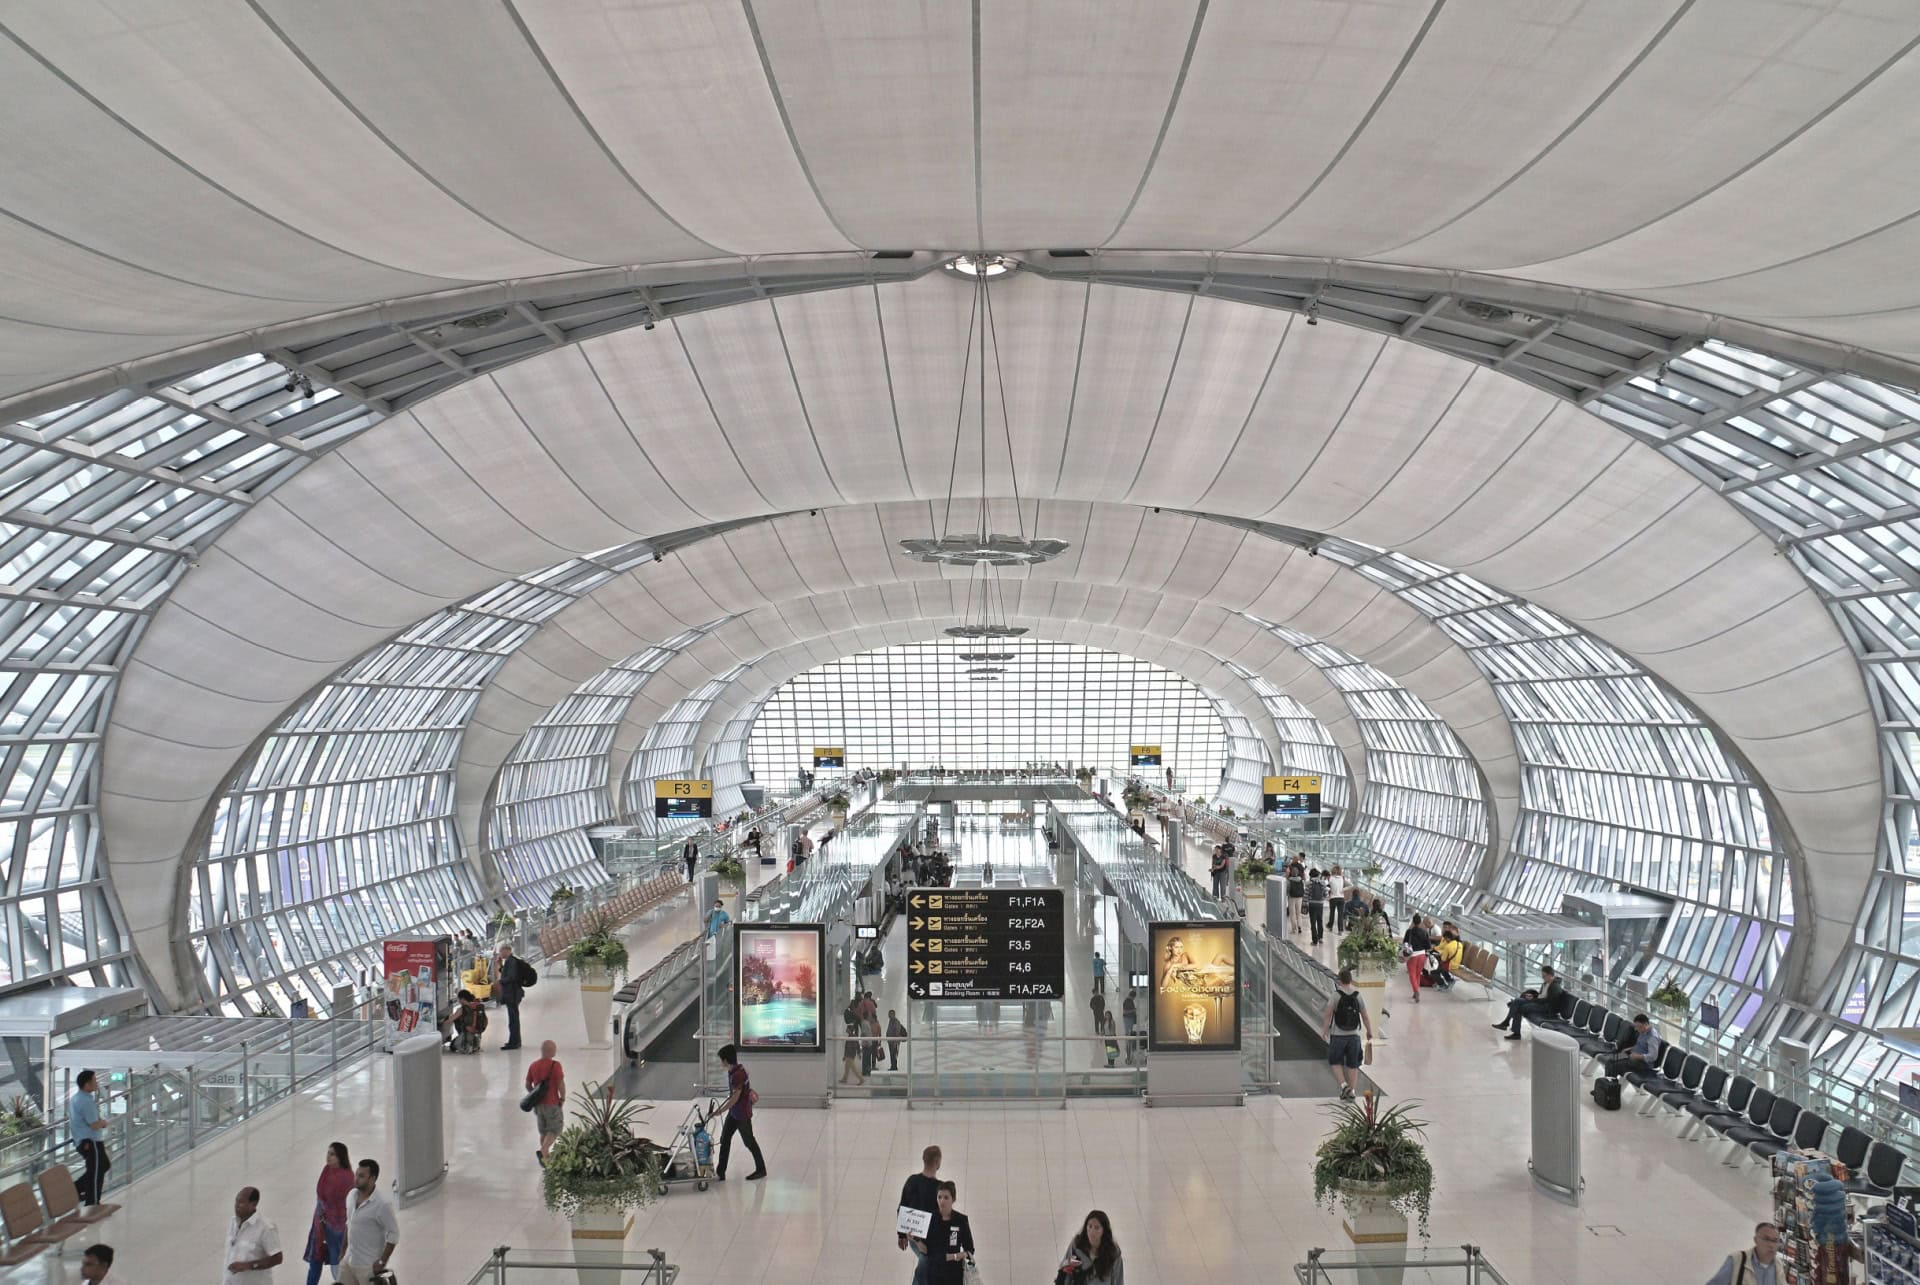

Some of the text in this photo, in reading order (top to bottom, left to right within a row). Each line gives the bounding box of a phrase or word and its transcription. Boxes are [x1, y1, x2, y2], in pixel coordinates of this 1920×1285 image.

[674, 783, 691, 795] F3
[1283, 779, 1300, 791] F4
[1009, 896, 1046, 908] F1,F1A
[1008, 918, 1045, 930] F2,F2A
[1009, 940, 1031, 952] F3,5
[1009, 962, 1032, 974] F4,6
[1009, 984, 1053, 996] F1A,F2A
[207, 1073, 236, 1084] Gate
